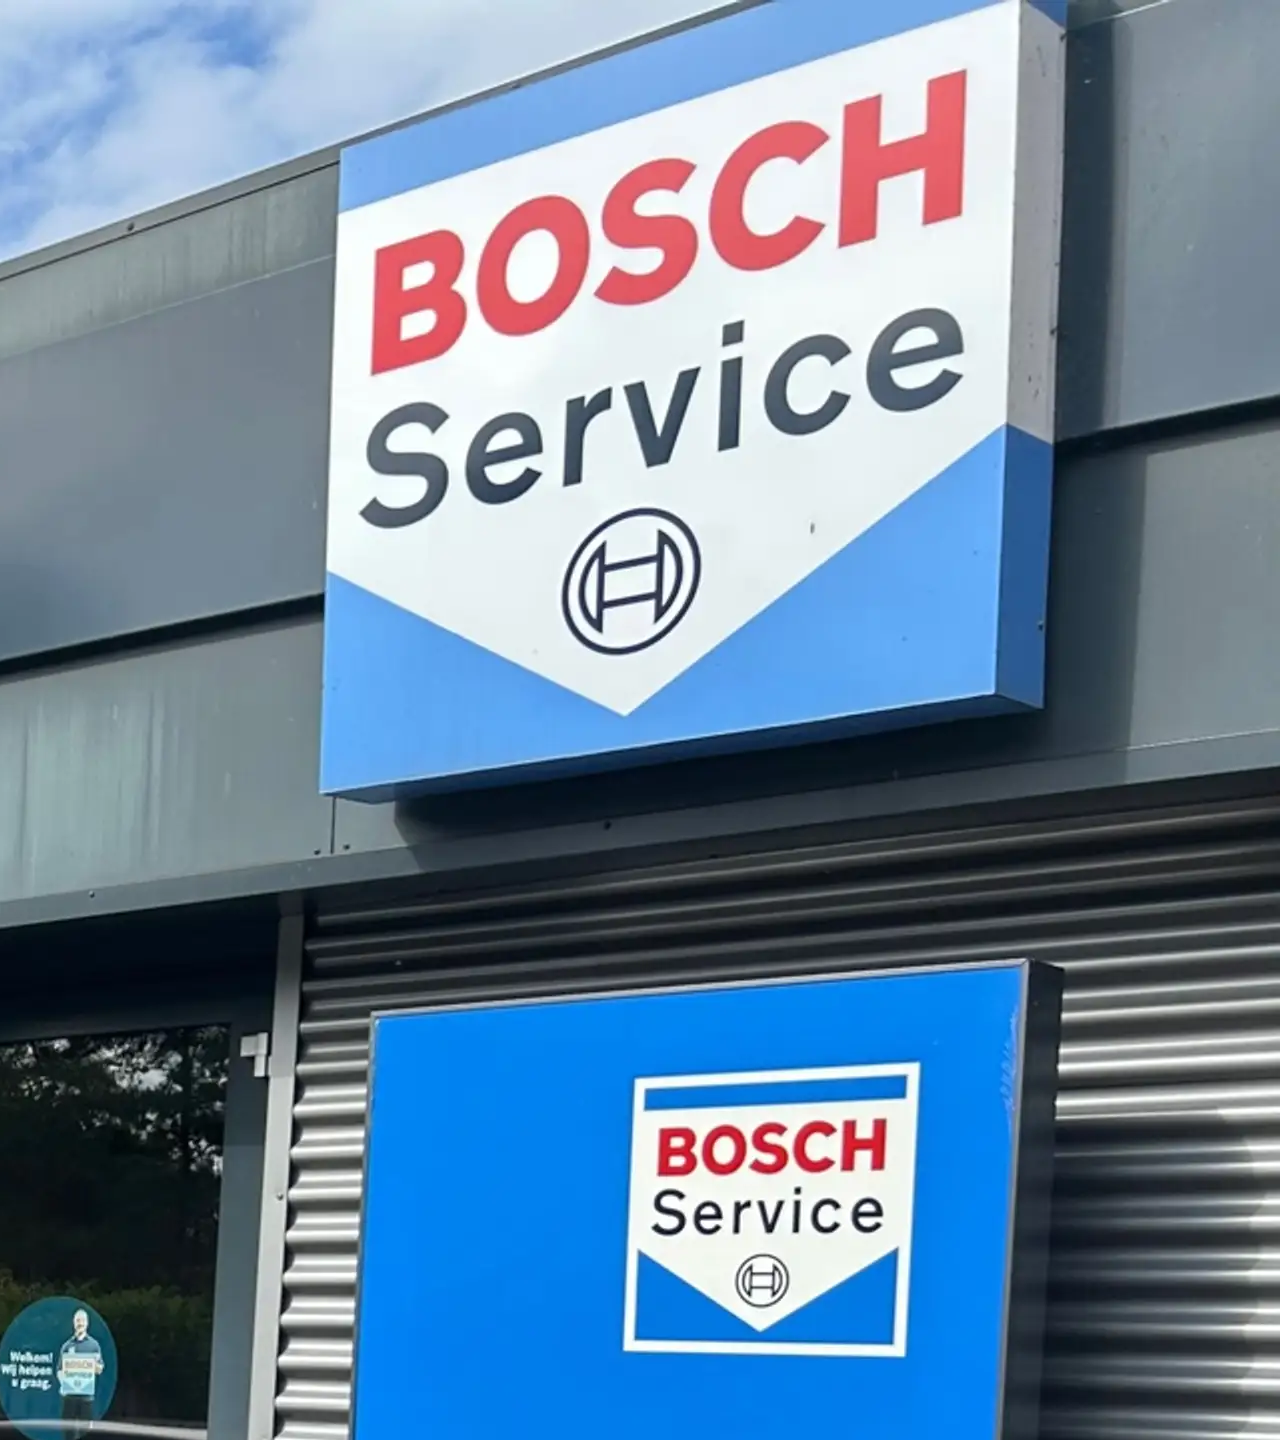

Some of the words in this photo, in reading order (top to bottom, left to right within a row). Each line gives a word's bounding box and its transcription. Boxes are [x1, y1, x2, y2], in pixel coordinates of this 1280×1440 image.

[371, 68, 967, 376] BOSCH
[358, 307, 964, 529] Service
[657, 1118, 887, 1176] BOSCH
[651, 1186, 884, 1235] Service
[10, 1351, 53, 1363] Welkom!
[18, 1364, 52, 1377] helpen
